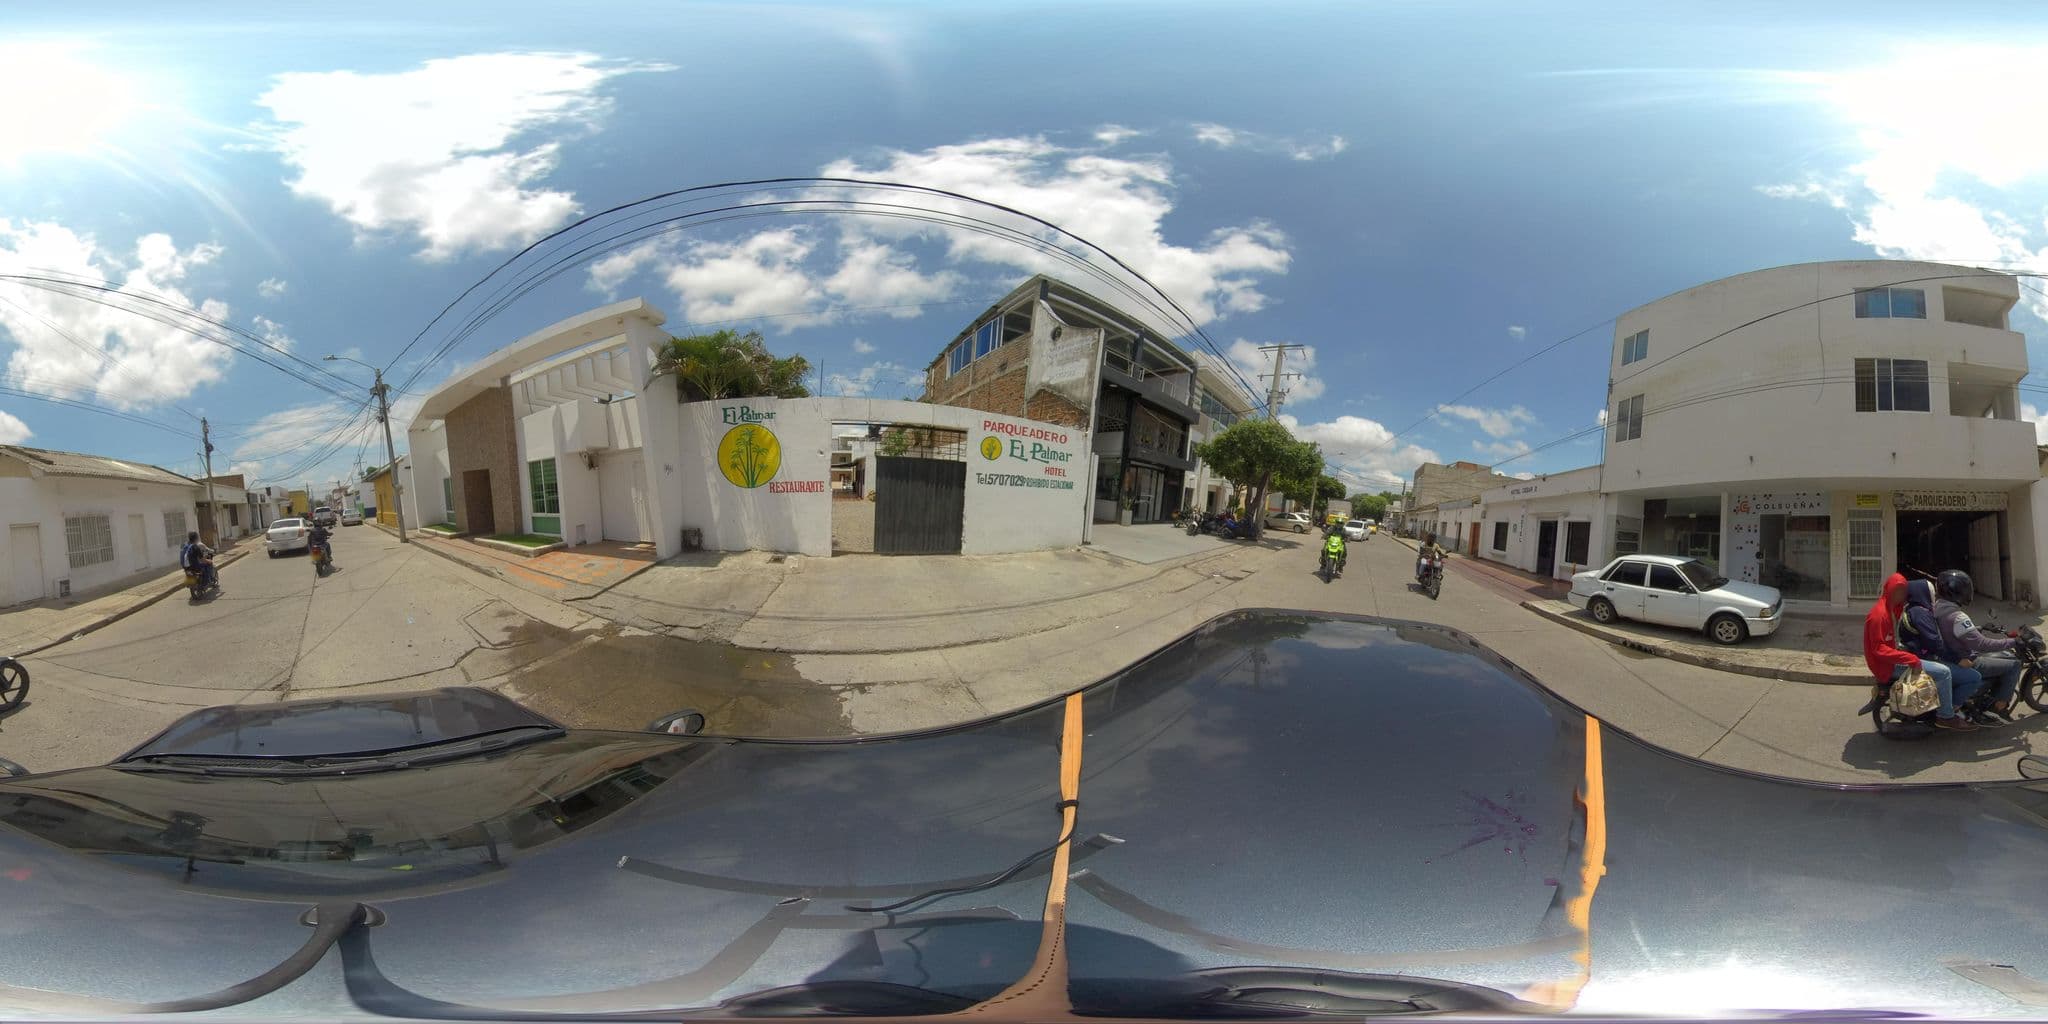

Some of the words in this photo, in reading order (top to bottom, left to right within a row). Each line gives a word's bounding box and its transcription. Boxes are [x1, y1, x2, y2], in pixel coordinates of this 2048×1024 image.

[722, 407, 738, 425] El
[984, 421, 1067, 444] PARQUEADERO
[1009, 439, 1028, 462] El
[1030, 442, 1073, 463] Palmar
[1044, 466, 1067, 477] HOTEL
[769, 481, 824, 493] RESTAURANTE
[1913, 494, 1967, 507] PARQUEADERO
